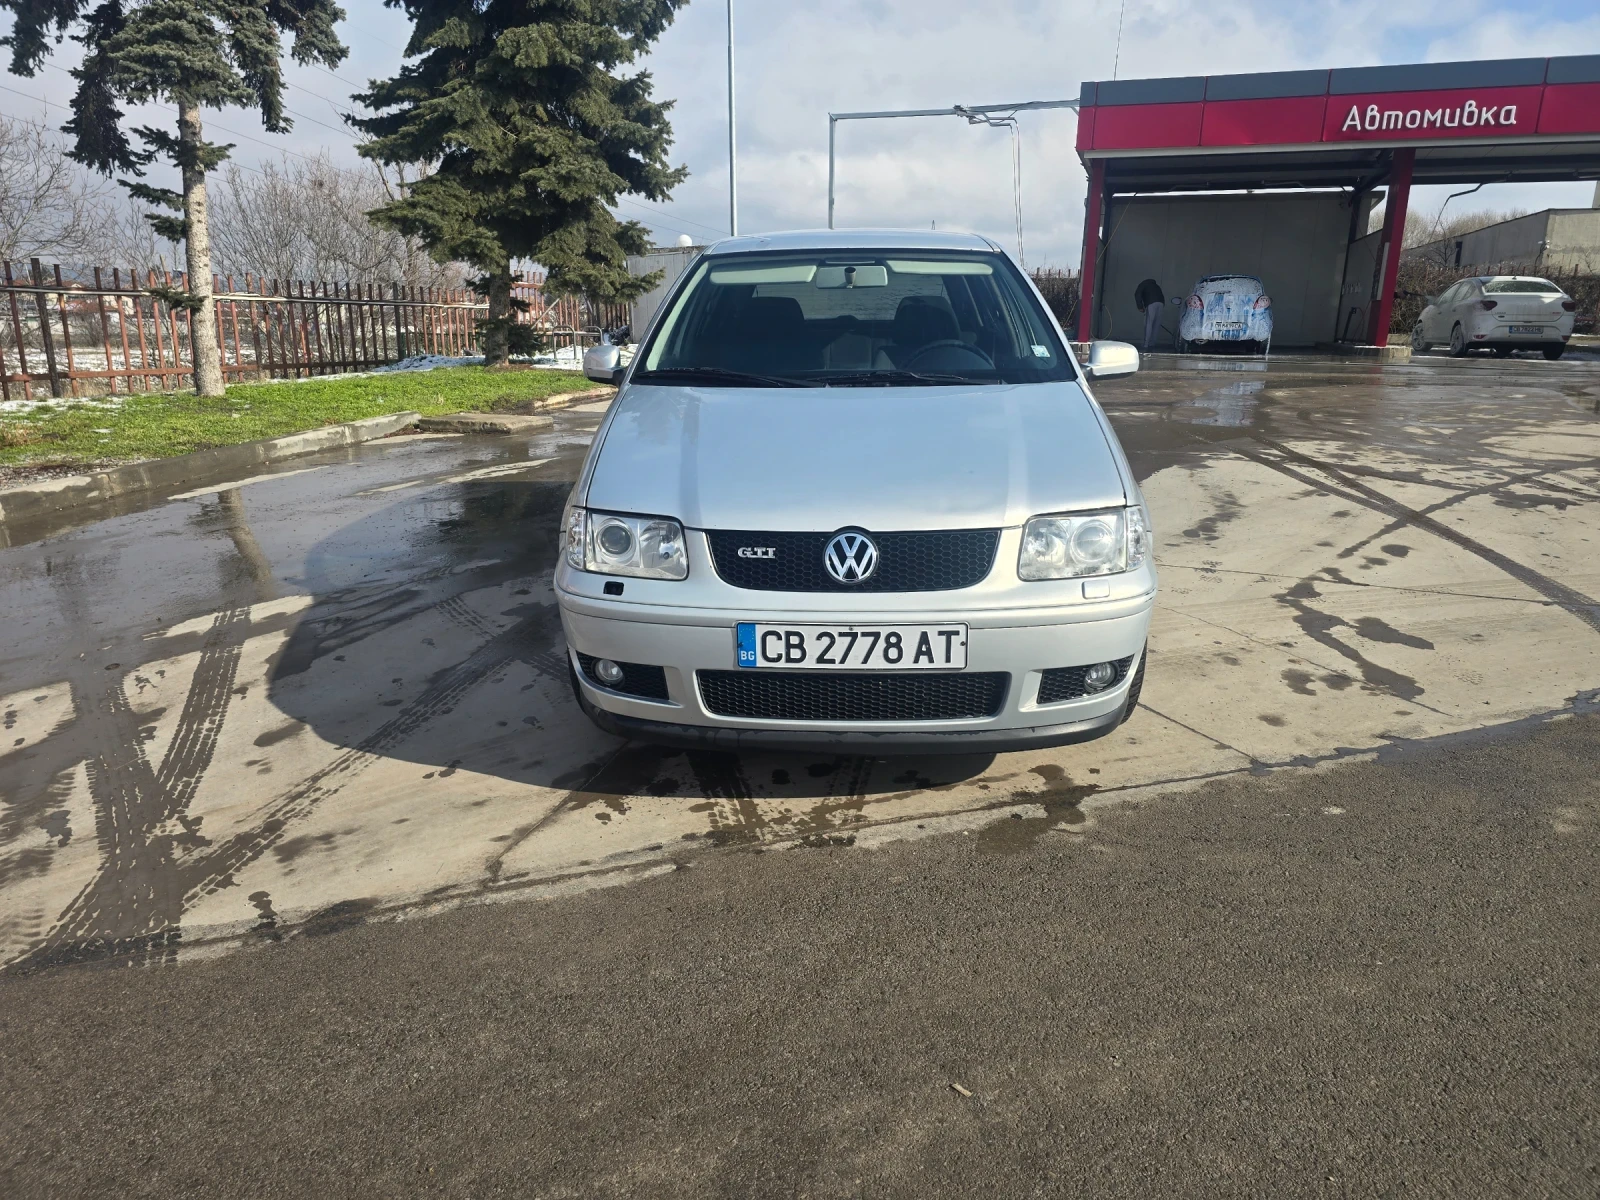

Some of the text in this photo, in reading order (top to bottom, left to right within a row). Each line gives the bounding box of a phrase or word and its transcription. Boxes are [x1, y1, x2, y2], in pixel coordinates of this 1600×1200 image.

[1342, 100, 1517, 132] Автомивка
[737, 547, 776, 559] GTI
[825, 532, 878, 583] VW
[740, 650, 755, 661] BG
[761, 630, 960, 665] CB 2778 AT
